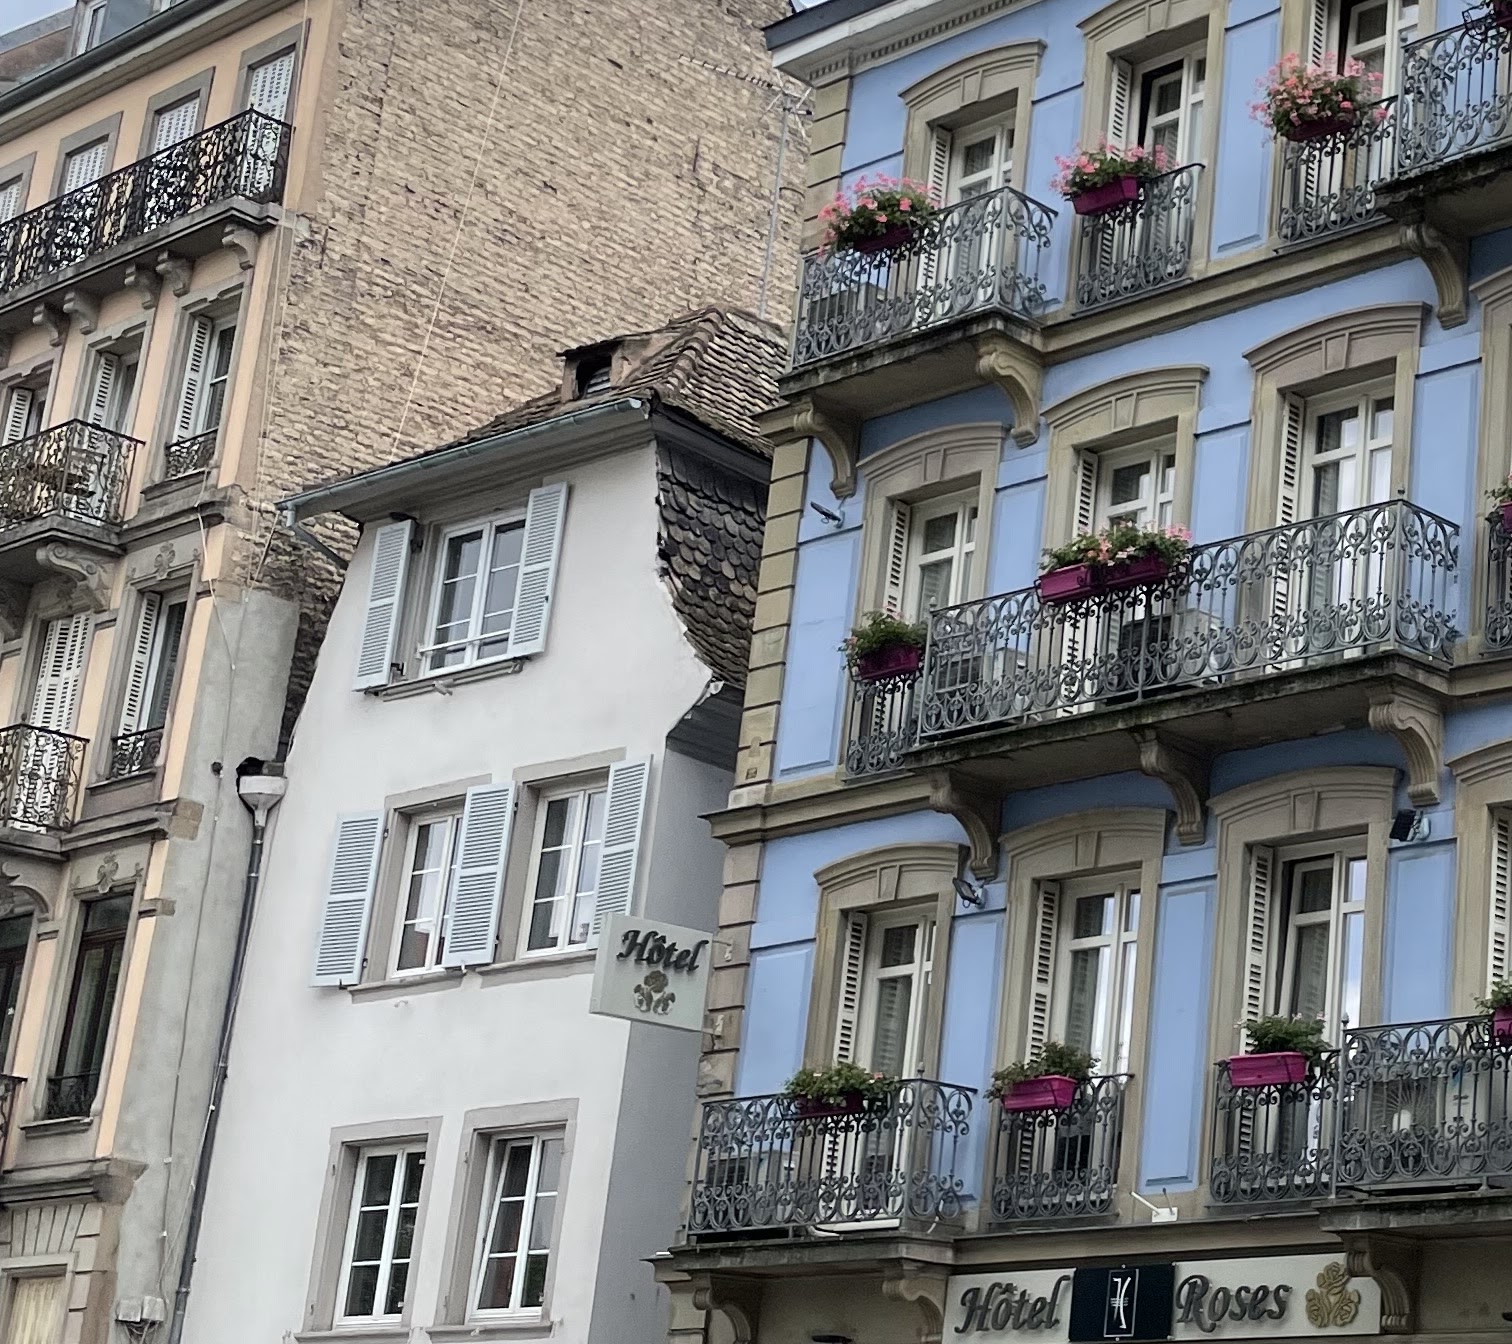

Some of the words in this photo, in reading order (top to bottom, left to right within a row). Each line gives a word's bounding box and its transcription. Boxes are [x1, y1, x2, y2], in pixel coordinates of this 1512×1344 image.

[616, 929, 710, 973] Hôtel
[953, 1274, 1070, 1334] Hôtel
[1175, 1274, 1293, 1333] Roses
